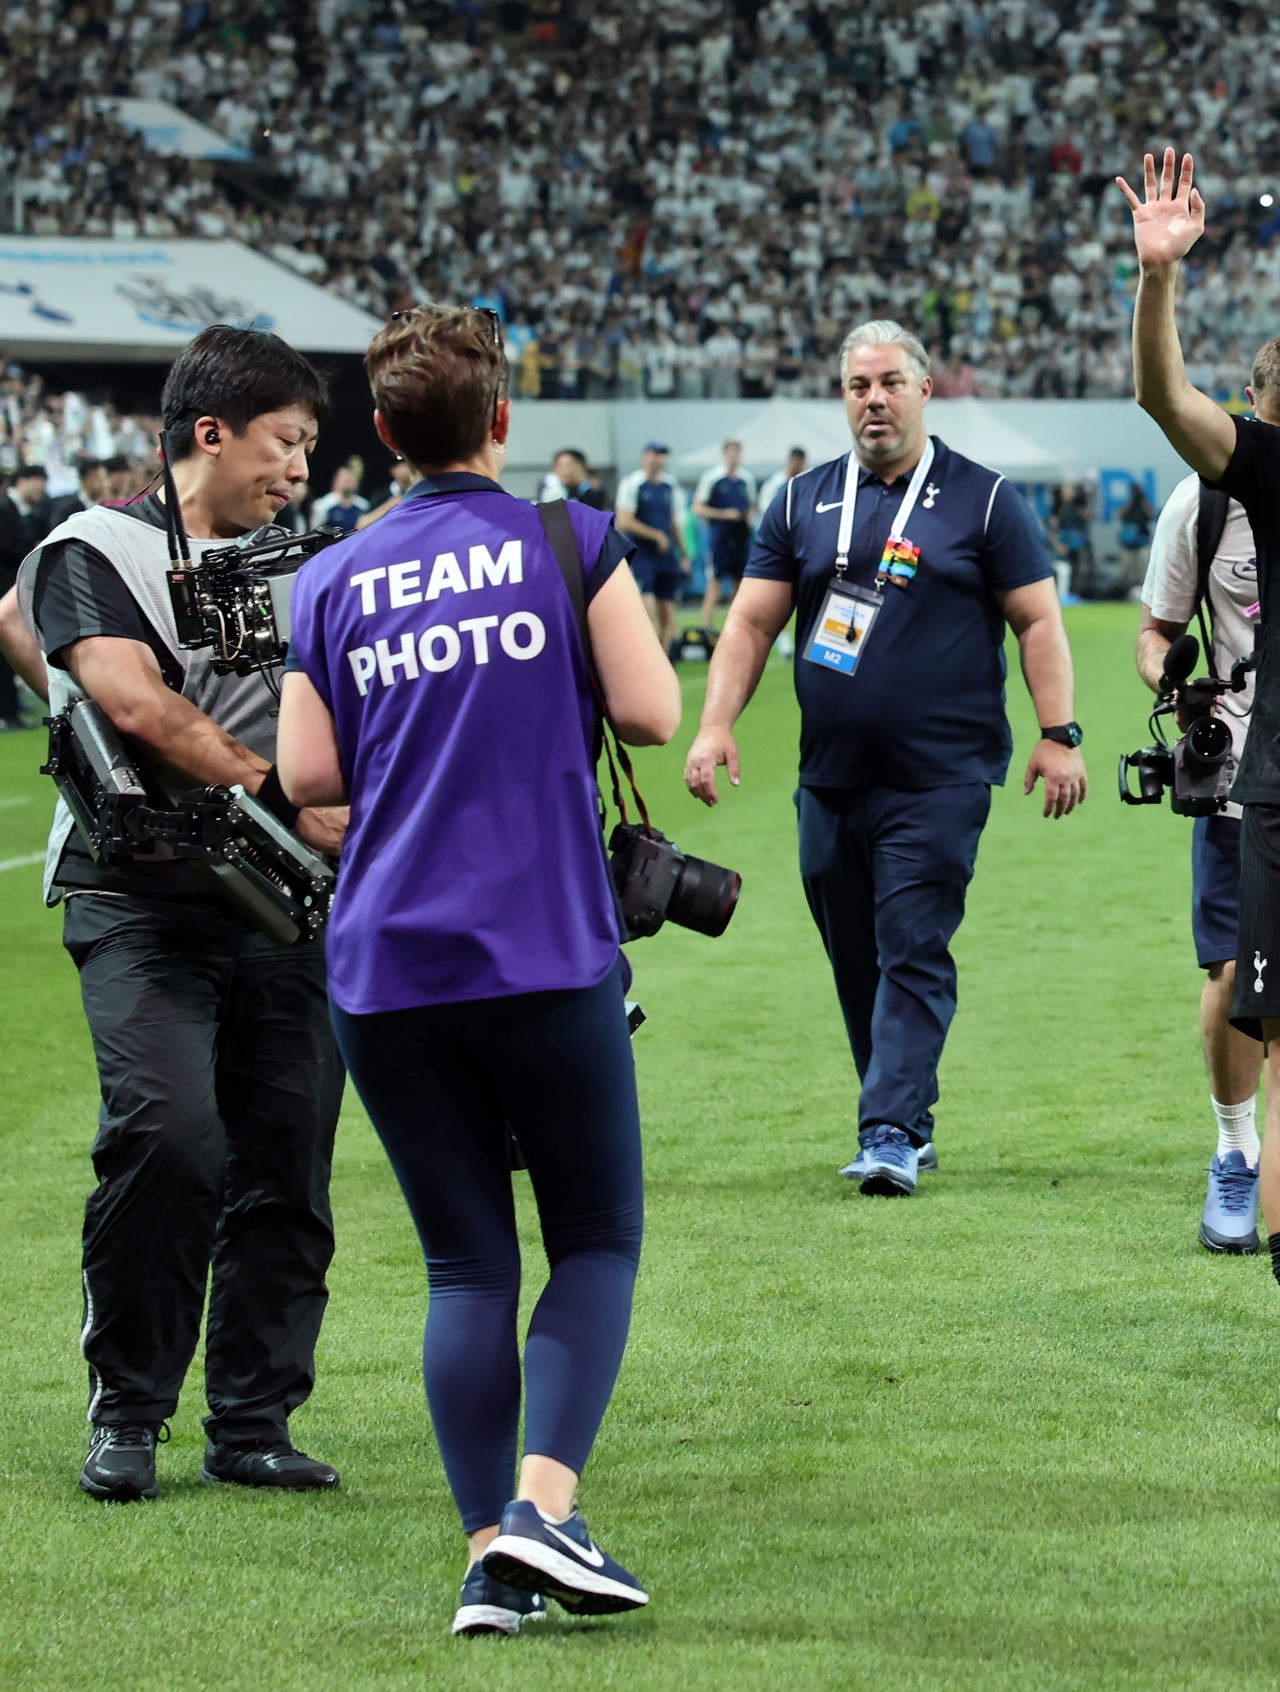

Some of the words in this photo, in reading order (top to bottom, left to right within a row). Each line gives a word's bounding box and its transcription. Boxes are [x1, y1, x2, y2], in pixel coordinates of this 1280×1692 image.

[350, 540, 523, 616] TEAM
[347, 611, 546, 697] PHOTO
[824, 650, 842, 665] M2
